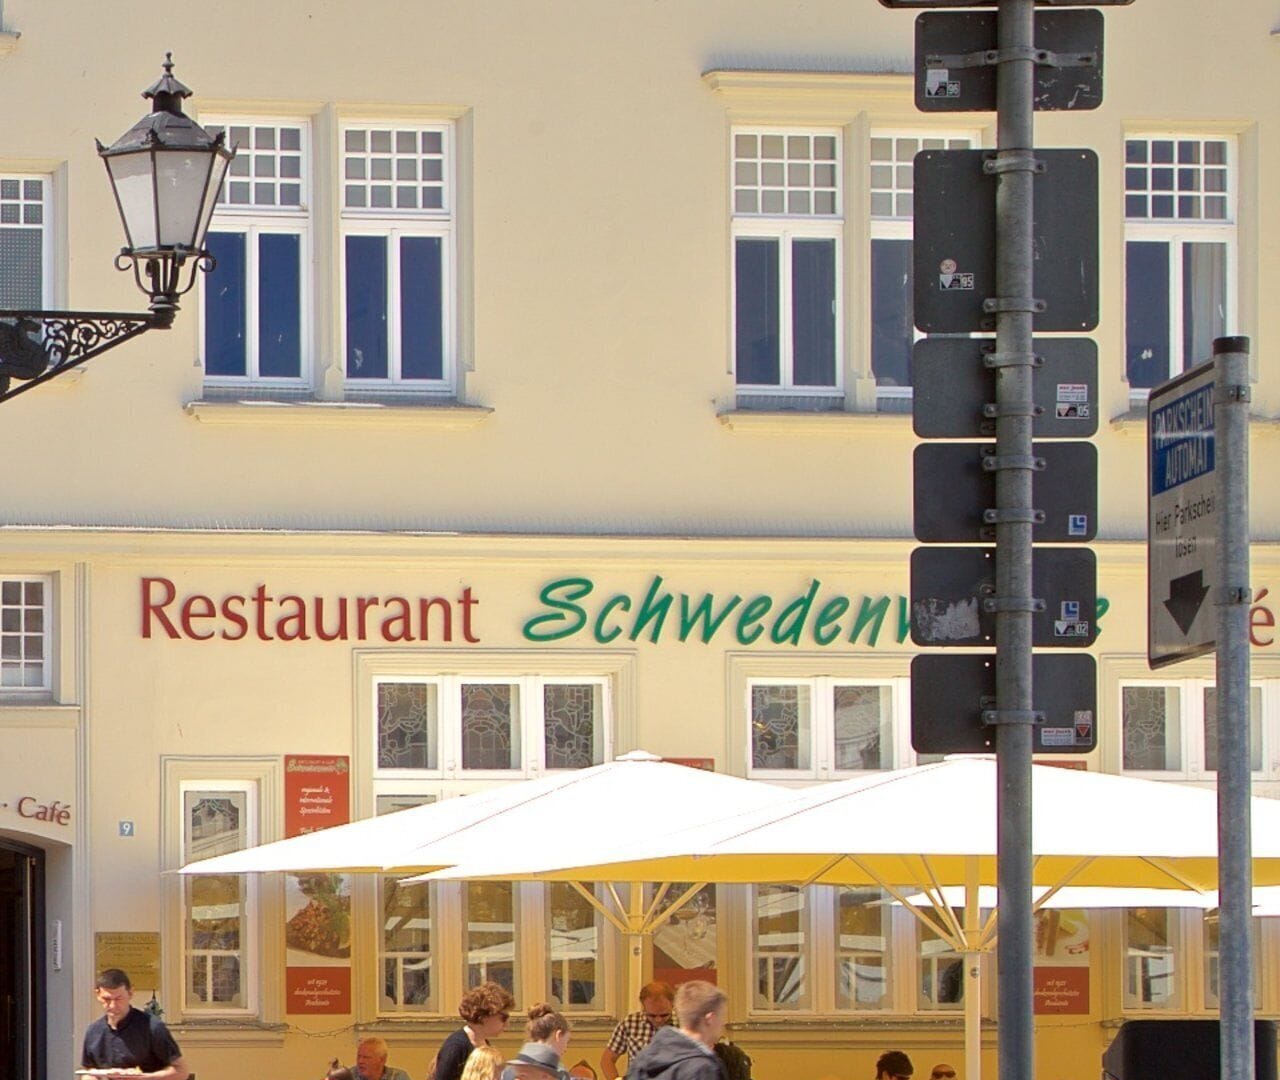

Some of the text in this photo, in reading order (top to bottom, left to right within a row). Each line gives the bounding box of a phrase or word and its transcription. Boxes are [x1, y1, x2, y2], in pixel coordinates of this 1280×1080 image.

[1156, 388, 1213, 450] PARKSCHEIN
[1165, 435, 1208, 487] AUTOMAT
[1155, 489, 1216, 536] Hier Parkschei
[1175, 536, 1197, 560] lösen
[141, 577, 481, 644] Restaurant
[17, 797, 71, 826] Café
[123, 822, 131, 835] 9
